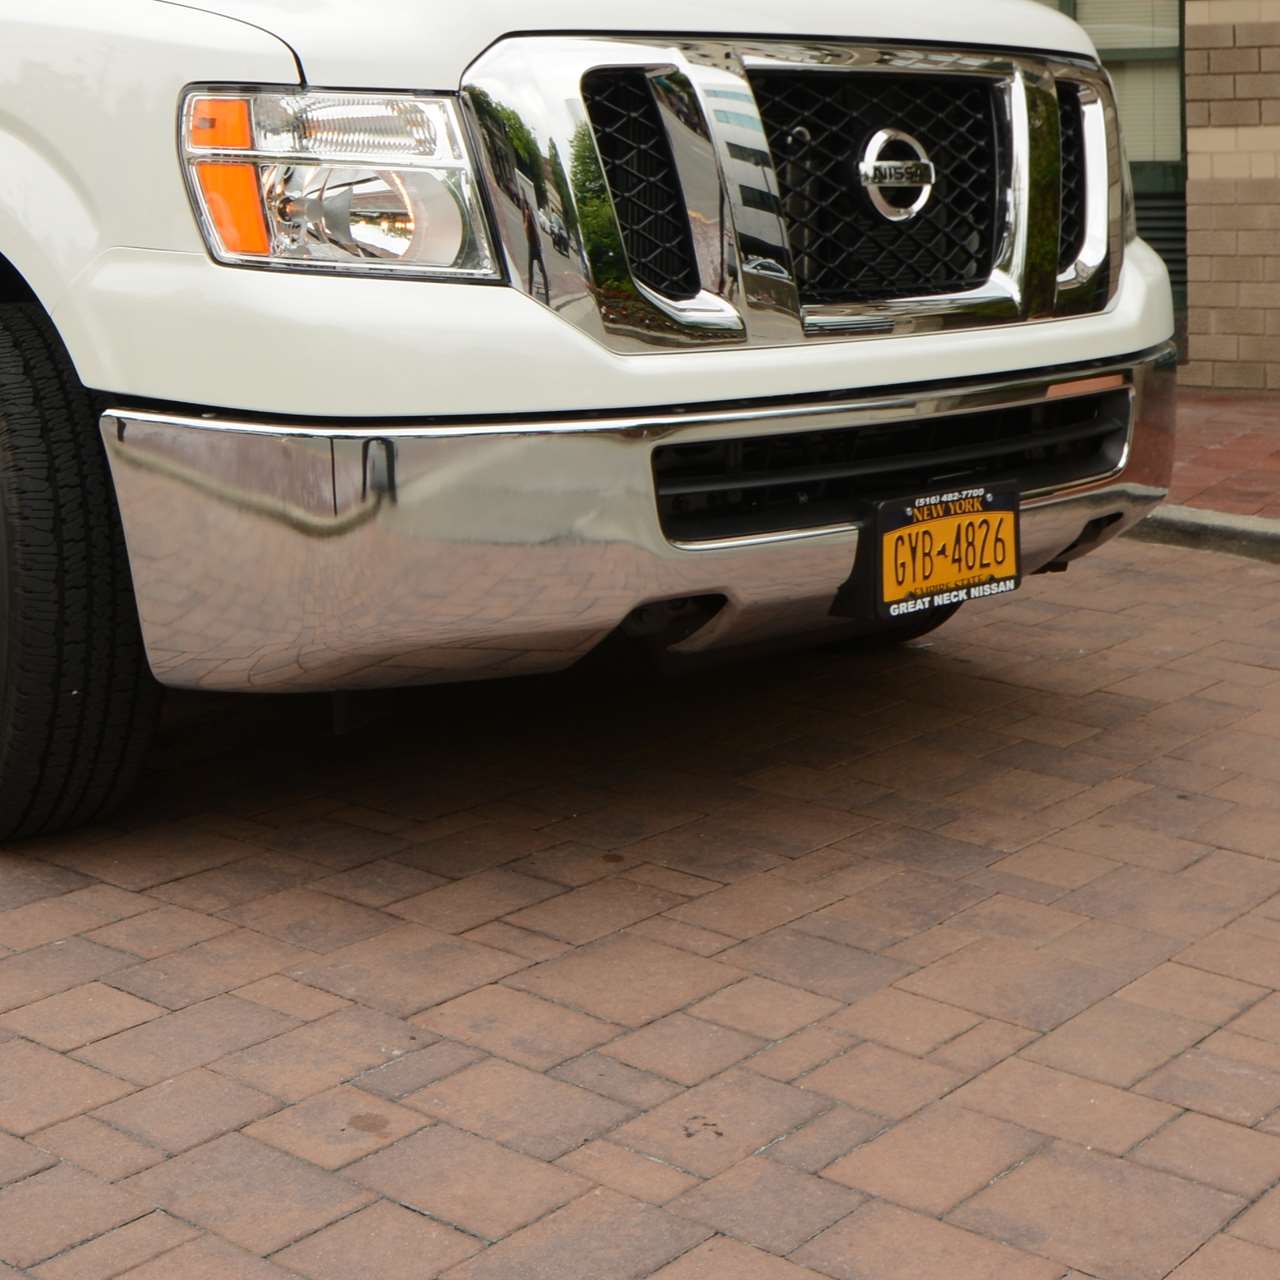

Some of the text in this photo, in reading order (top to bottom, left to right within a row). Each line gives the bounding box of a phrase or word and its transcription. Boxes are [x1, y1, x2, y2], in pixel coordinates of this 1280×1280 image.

[913, 497, 983, 522] NEW YORK
[915, 488, 985, 507] (516) 482-7700
[894, 517, 1006, 586] GYB 4826
[889, 579, 1015, 616] GREAT NECK NISSAN
